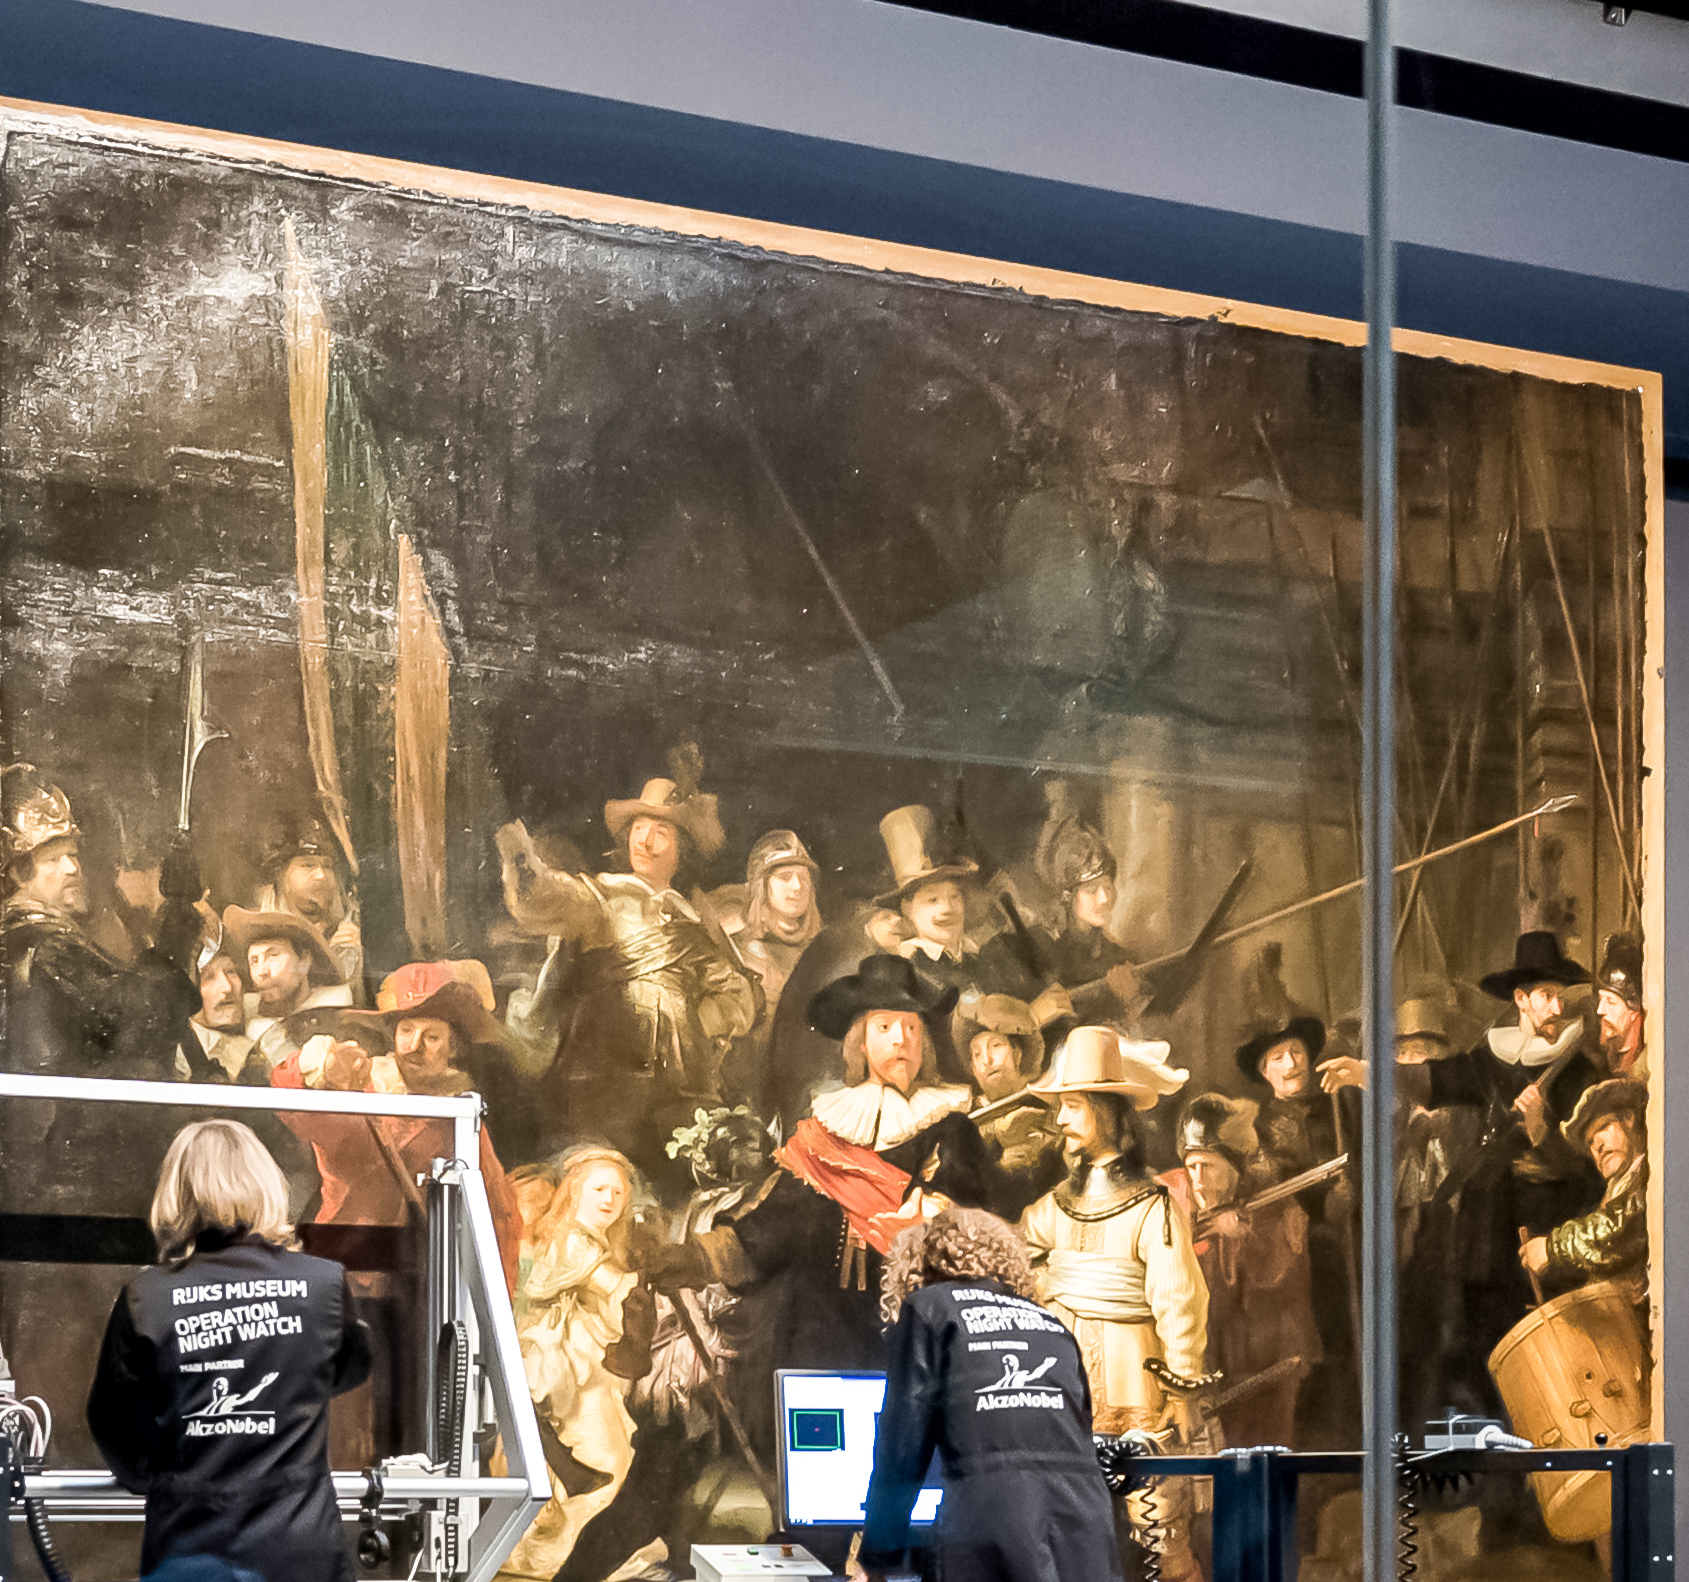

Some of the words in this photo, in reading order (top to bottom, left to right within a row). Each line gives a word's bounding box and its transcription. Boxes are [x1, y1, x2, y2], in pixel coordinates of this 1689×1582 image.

[225, 1279, 308, 1299] MUSEUM
[174, 1300, 279, 1336] OPERATION
[965, 1317, 1013, 1335] NIGHT
[1013, 1318, 1065, 1334] WATCH
[178, 1326, 233, 1354] NIGHT
[236, 1315, 303, 1342] WATCH
[975, 1391, 1065, 1412] AkzoNobel
[185, 1416, 276, 1436] AkzoNobel
